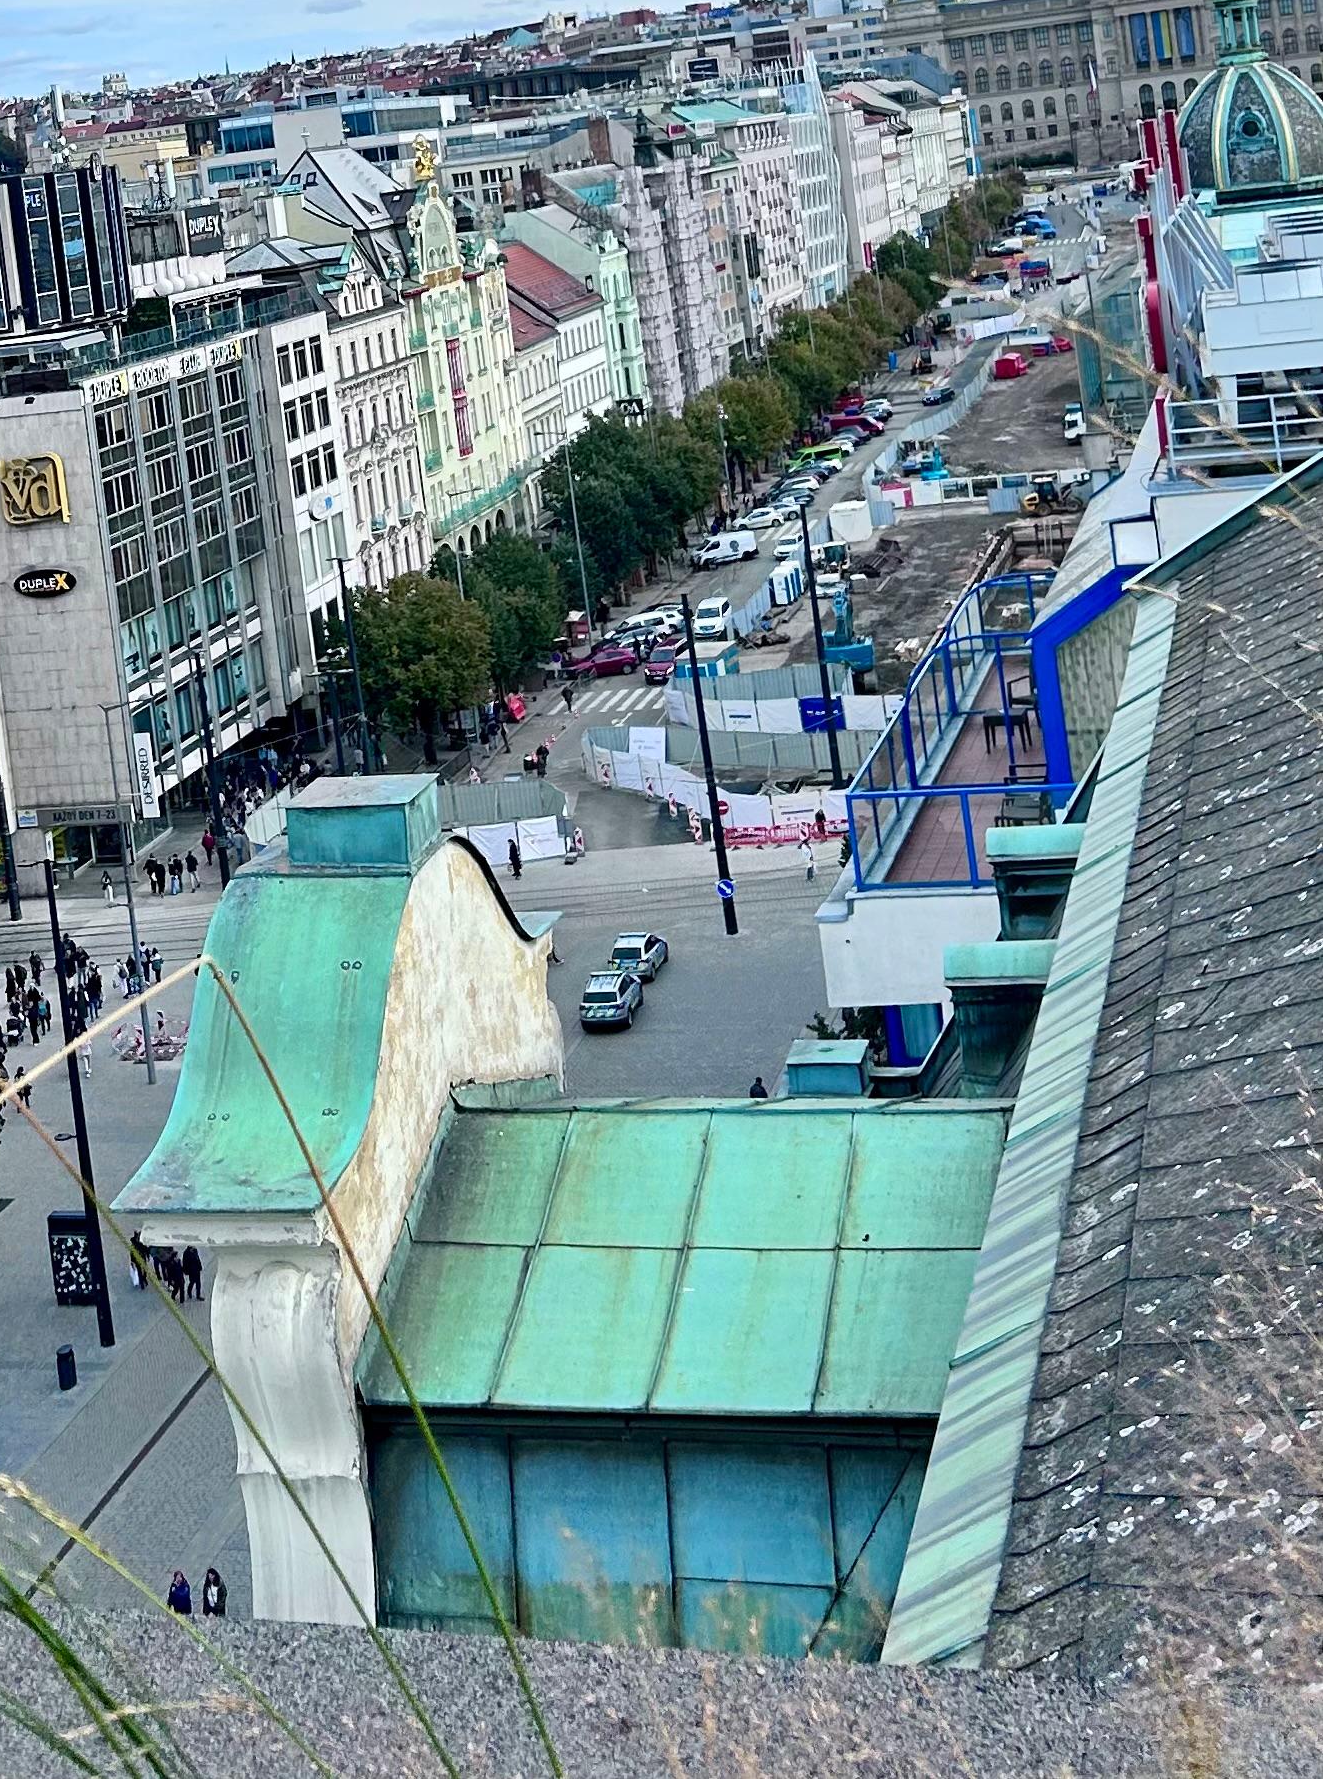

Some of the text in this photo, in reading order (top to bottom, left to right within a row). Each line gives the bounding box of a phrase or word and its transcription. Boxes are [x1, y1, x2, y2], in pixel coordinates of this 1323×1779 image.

[188, 215, 221, 238] DUPLEX
[19, 573, 70, 591] DUPLEX
[138, 747, 154, 805] DESIRRED
